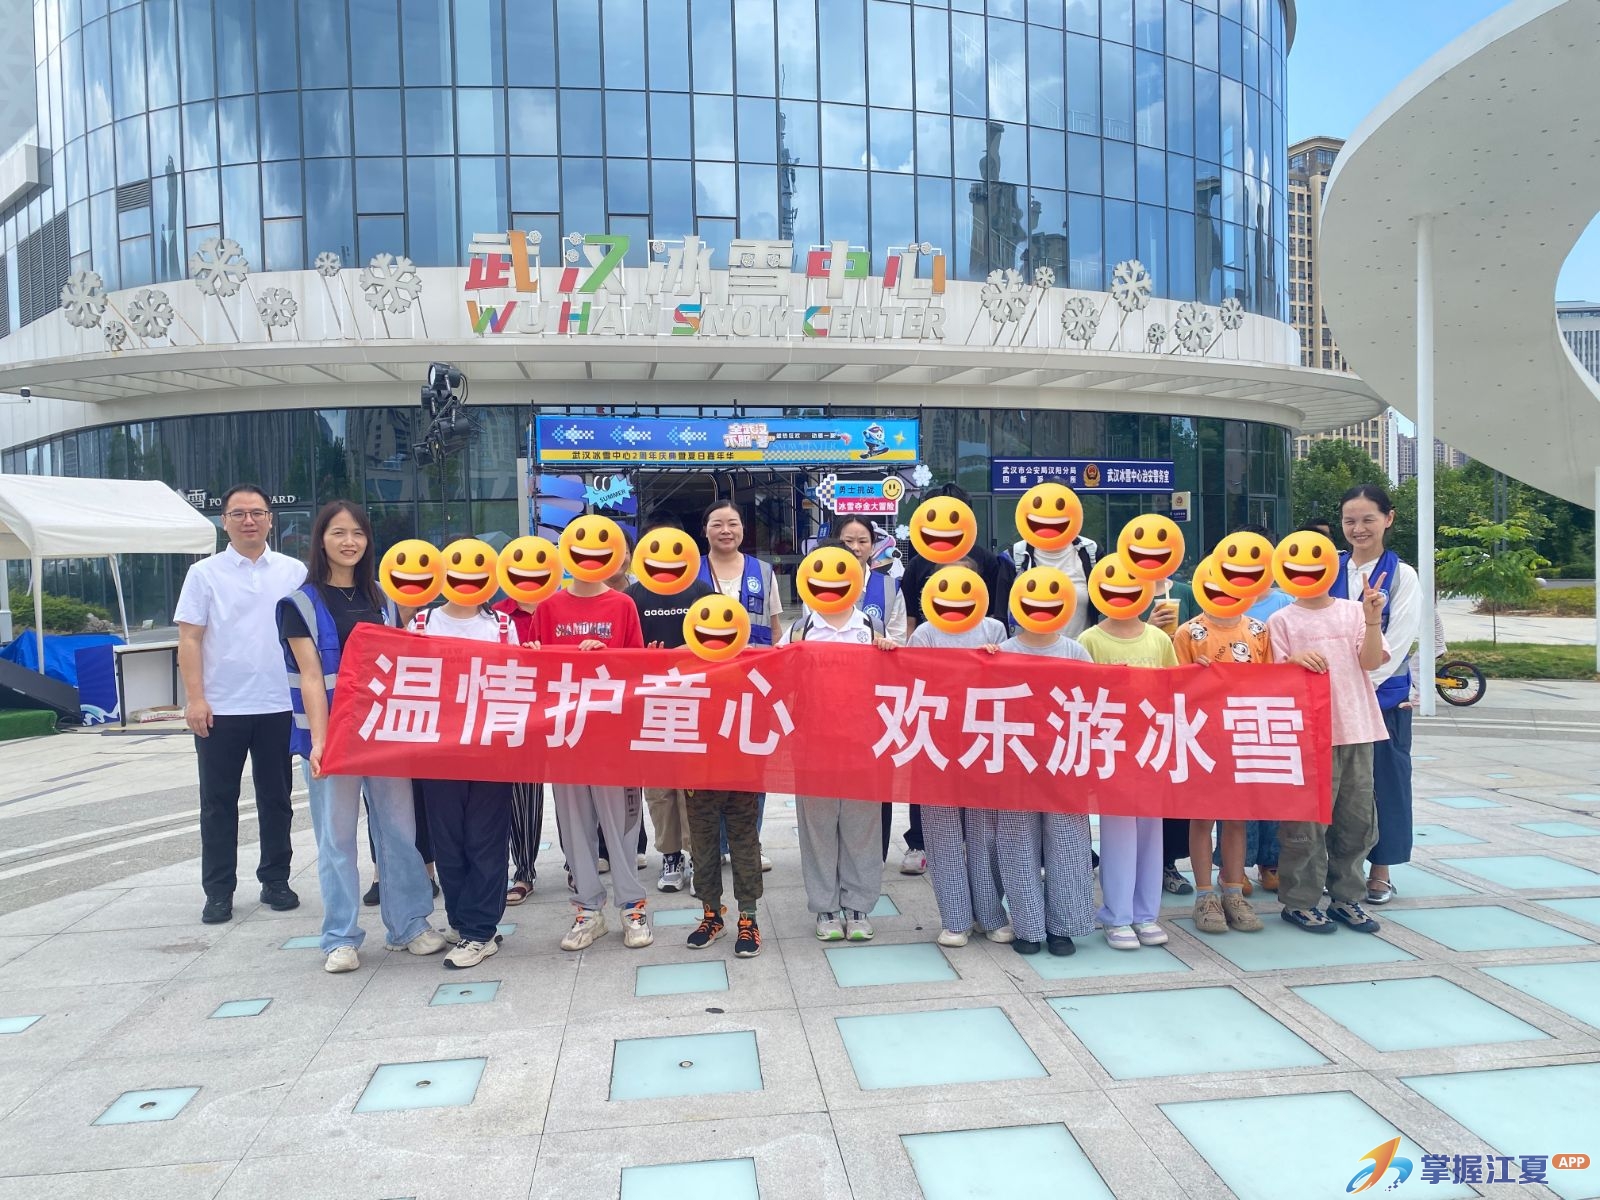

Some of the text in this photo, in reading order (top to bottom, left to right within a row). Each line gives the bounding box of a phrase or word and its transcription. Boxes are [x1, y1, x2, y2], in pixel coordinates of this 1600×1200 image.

[464, 230, 946, 300] 武汉冰雪中心
[466, 300, 947, 339] WUHAN SNOW CENTER
[1002, 466, 1077, 475] 武汉市公安局汉阳分局
[1106, 468, 1170, 484] 武汉冰雪中心治安警务室
[1002, 475, 1077, 484] 四新派所
[600, 489, 626, 502] SUMMER
[839, 486, 875, 494] 勇士挑战
[838, 502, 895, 511] 冰雪夺金大冒险
[358, 653, 1305, 787] 温情护童心 欢乐游冰雪
